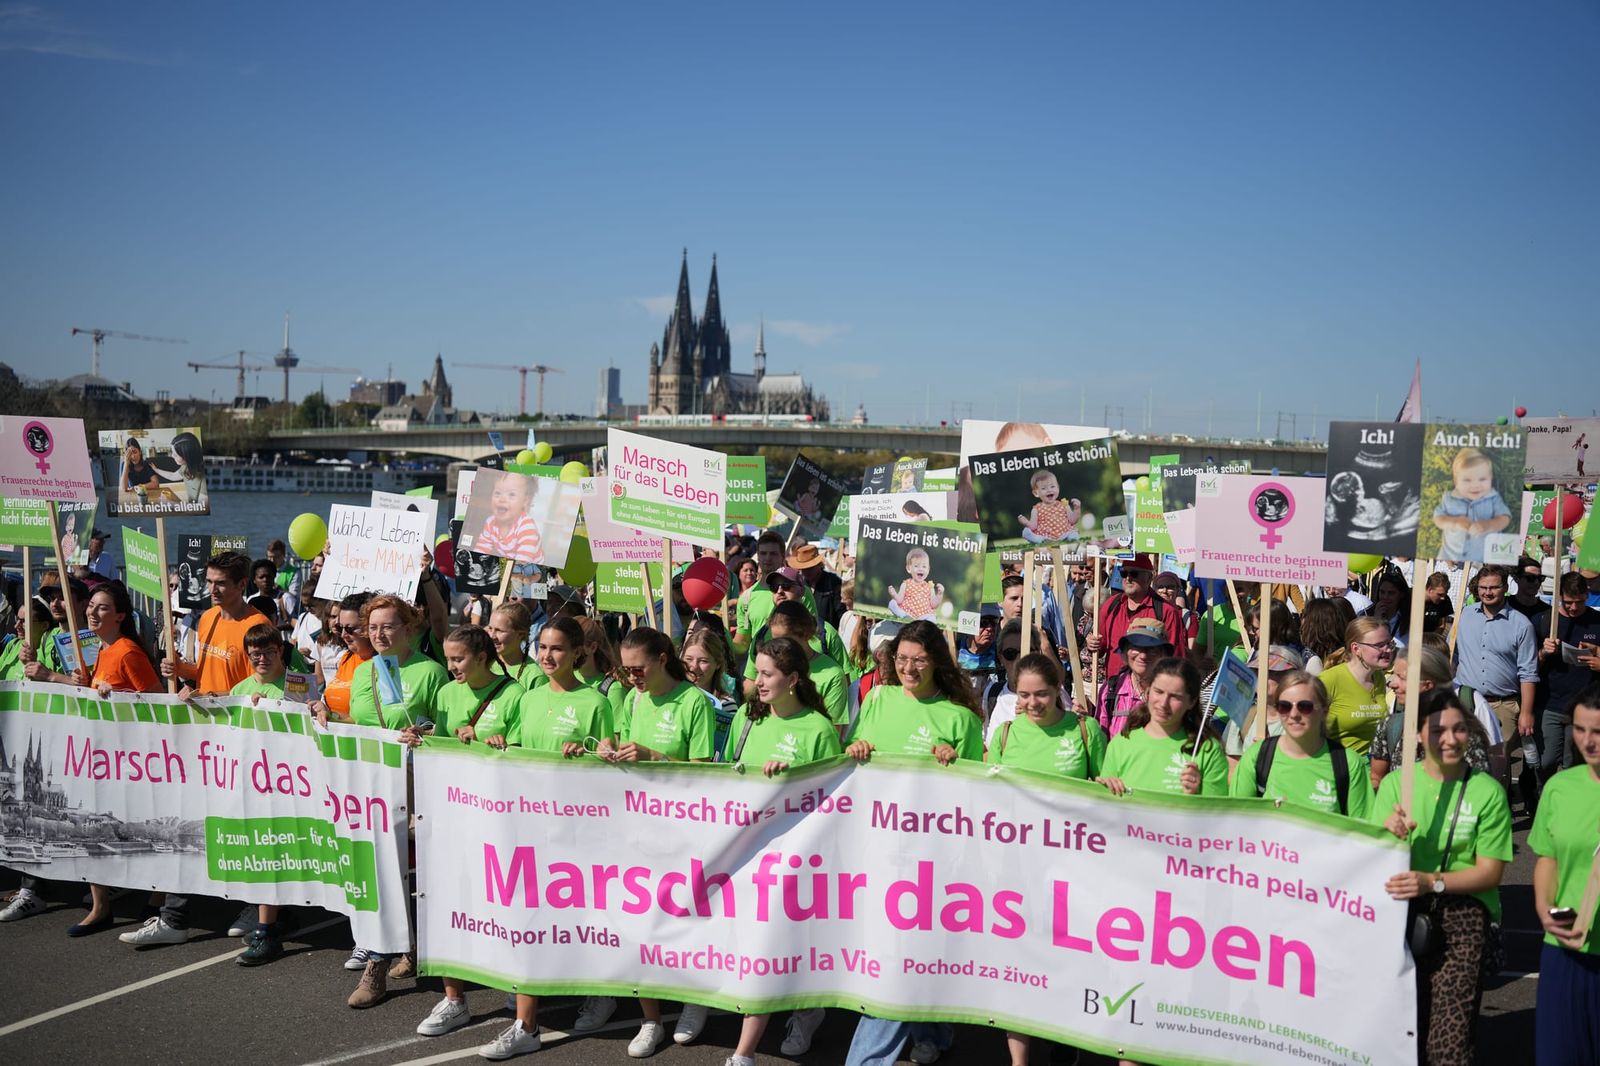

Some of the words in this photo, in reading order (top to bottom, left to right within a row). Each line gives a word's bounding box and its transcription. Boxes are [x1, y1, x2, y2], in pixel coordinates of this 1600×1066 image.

[1360, 429, 1395, 445] Ich!
[1432, 431, 1480, 447] Auch
[1485, 432, 1521, 449] ich!
[1552, 425, 1572, 434] Papa!
[623, 446, 688, 478] Marsch
[973, 460, 997, 476] Das
[1000, 456, 1040, 473] Leben
[1043, 450, 1063, 467] ist
[1067, 442, 1113, 463] schön!
[1163, 468, 1178, 478] Das
[1180, 466, 1204, 477] Leben
[1206, 465, 1218, 474] ist
[1221, 463, 1248, 474] schön!
[1, 475, 54, 487] Frauenrechte
[54, 478, 92, 489] beginnen
[20, 487, 30, 496] im
[32, 488, 78, 499] Mutterleib!
[614, 465, 632, 480] für
[634, 471, 659, 488] das
[663, 477, 719, 507] Leben
[110, 502, 123, 513] Du
[124, 502, 143, 513] bist
[145, 501, 172, 513] nicht
[174, 500, 206, 512] allein!
[332, 510, 374, 539] Wähle
[380, 512, 421, 545] Leben:
[862, 524, 882, 540] Das
[885, 527, 919, 545] Leben
[922, 531, 939, 548] ist
[942, 535, 982, 554] schön!
[126, 538, 158, 565] Inklusion
[188, 538, 201, 548] Ich!
[213, 540, 232, 549] Auch
[593, 539, 648, 549] Frauenrechte
[612, 550, 624, 559] im
[1002, 551, 1022, 561] bist
[1034, 551, 1051, 562] cht
[1062, 551, 1084, 562] lein!
[341, 543, 370, 571] deine
[375, 545, 416, 575] MAMA
[1201, 549, 1281, 565] Frauenrechte
[1285, 554, 1343, 568] beginnen
[1226, 564, 1240, 576] im
[1245, 566, 1316, 580] Mutterleib!
[599, 584, 610, 593] zu
[613, 582, 640, 596] ihrem
[64, 735, 187, 784] Marsch
[198, 740, 239, 792] für
[251, 748, 312, 798] das
[446, 786, 480, 810] Mars
[480, 796, 515, 814] voor
[519, 795, 550, 816] het
[553, 801, 610, 818] Leven
[624, 789, 718, 825] Marsch
[723, 800, 776, 828] fürs
[784, 787, 853, 815] Läbe
[226, 833, 250, 846] zum
[254, 827, 296, 846] Leben
[871, 800, 975, 837] March
[982, 812, 1031, 846] for
[1042, 818, 1108, 855] Life
[1126, 823, 1193, 849] Marcia
[1198, 835, 1234, 857] per
[1238, 834, 1257, 855] la
[1260, 840, 1300, 865] Vita
[244, 852, 321, 875] Abtreibung
[1165, 855, 1260, 890] Marcha
[1266, 875, 1319, 907] pela
[1324, 886, 1377, 924] Vida
[450, 910, 509, 942] Marcha
[510, 924, 547, 948] por
[552, 923, 573, 945] la
[575, 926, 621, 948] Vida
[483, 842, 737, 920] Marsch
[751, 852, 868, 923] für
[884, 860, 1027, 940] das
[1051, 880, 1317, 998] Leben
[639, 943, 736, 973] Marche
[738, 953, 802, 980] pour
[810, 947, 835, 972] la
[840, 948, 881, 979] Vie
[903, 957, 974, 977] Pochod
[978, 963, 1000, 980] za
[1003, 965, 1049, 990] život
[1156, 1002, 1266, 1031] BUNDESVERBAND
[1268, 1022, 1350, 1057] LEBENSRECHT
